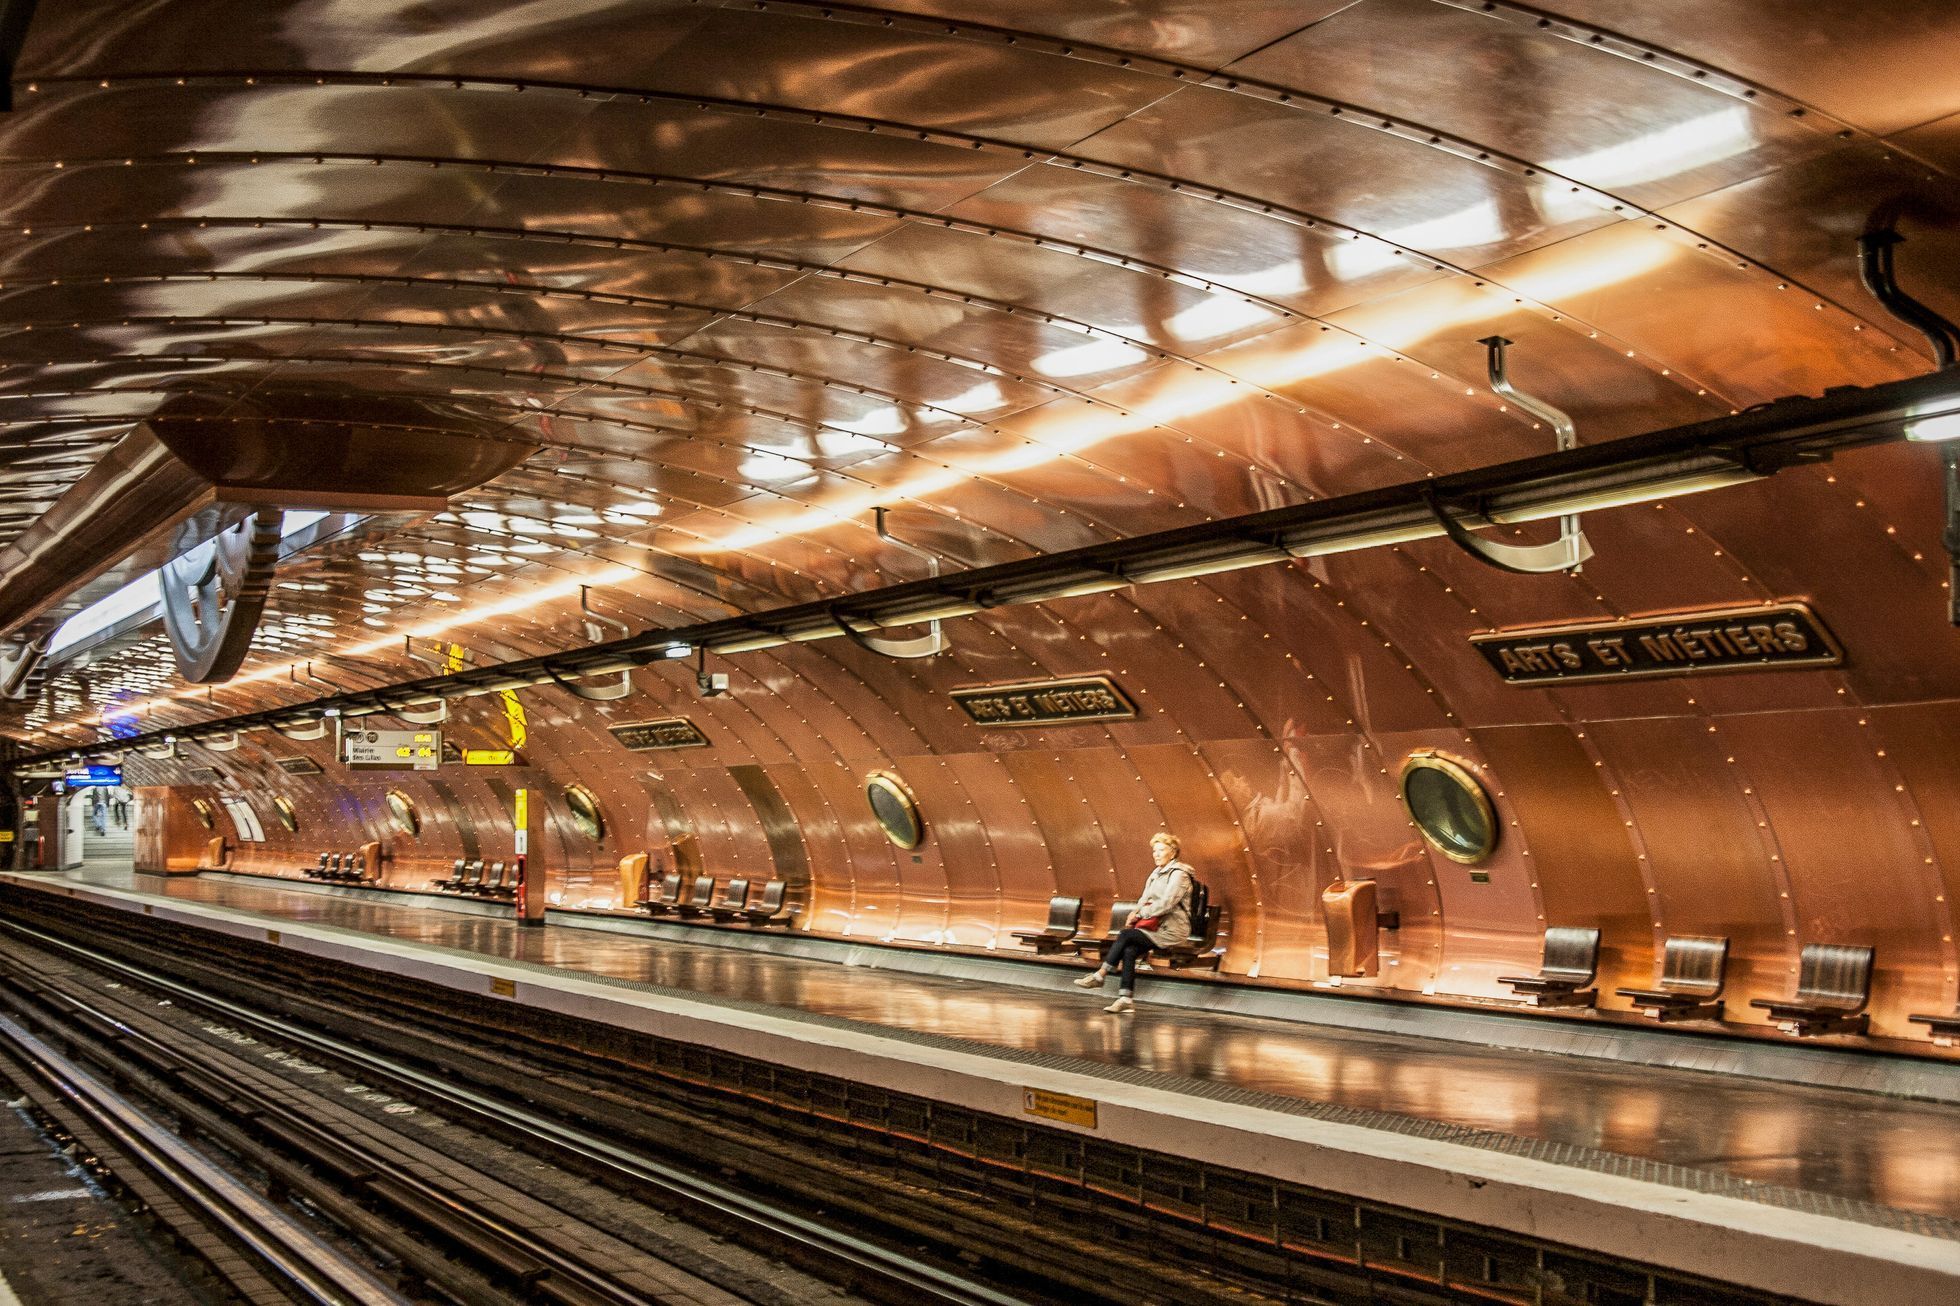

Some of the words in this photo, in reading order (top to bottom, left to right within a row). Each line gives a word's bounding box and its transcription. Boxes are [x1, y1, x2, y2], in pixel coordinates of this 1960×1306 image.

[1499, 643, 1582, 673] ARTS
[1588, 638, 1632, 667] ET
[1640, 623, 1807, 662] MÉTIERS
